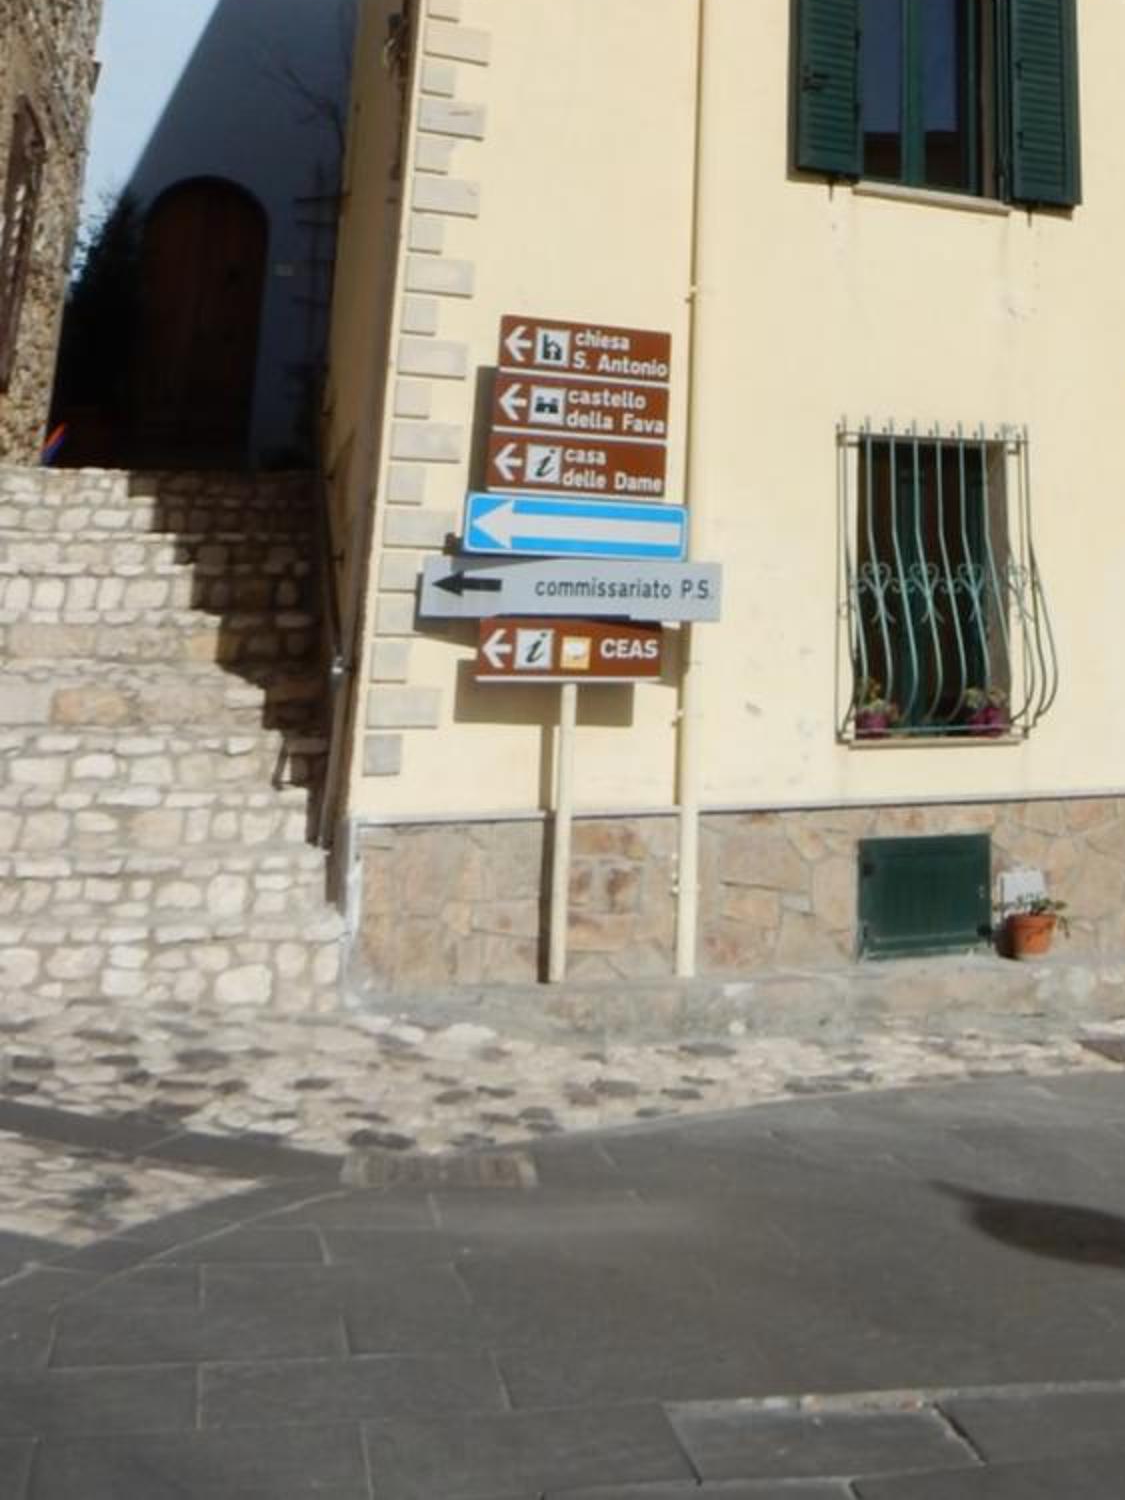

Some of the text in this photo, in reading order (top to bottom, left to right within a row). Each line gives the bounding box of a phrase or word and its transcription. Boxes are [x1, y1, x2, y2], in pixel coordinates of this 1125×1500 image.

[575, 329, 630, 351] chiesa
[574, 350, 668, 378] S. Antonio
[567, 389, 647, 410] castello
[566, 409, 665, 434] della Fava
[564, 449, 607, 466] casa
[562, 468, 662, 492] delle Dame
[534, 577, 672, 598] commissariato
[600, 638, 658, 659] CEAS
